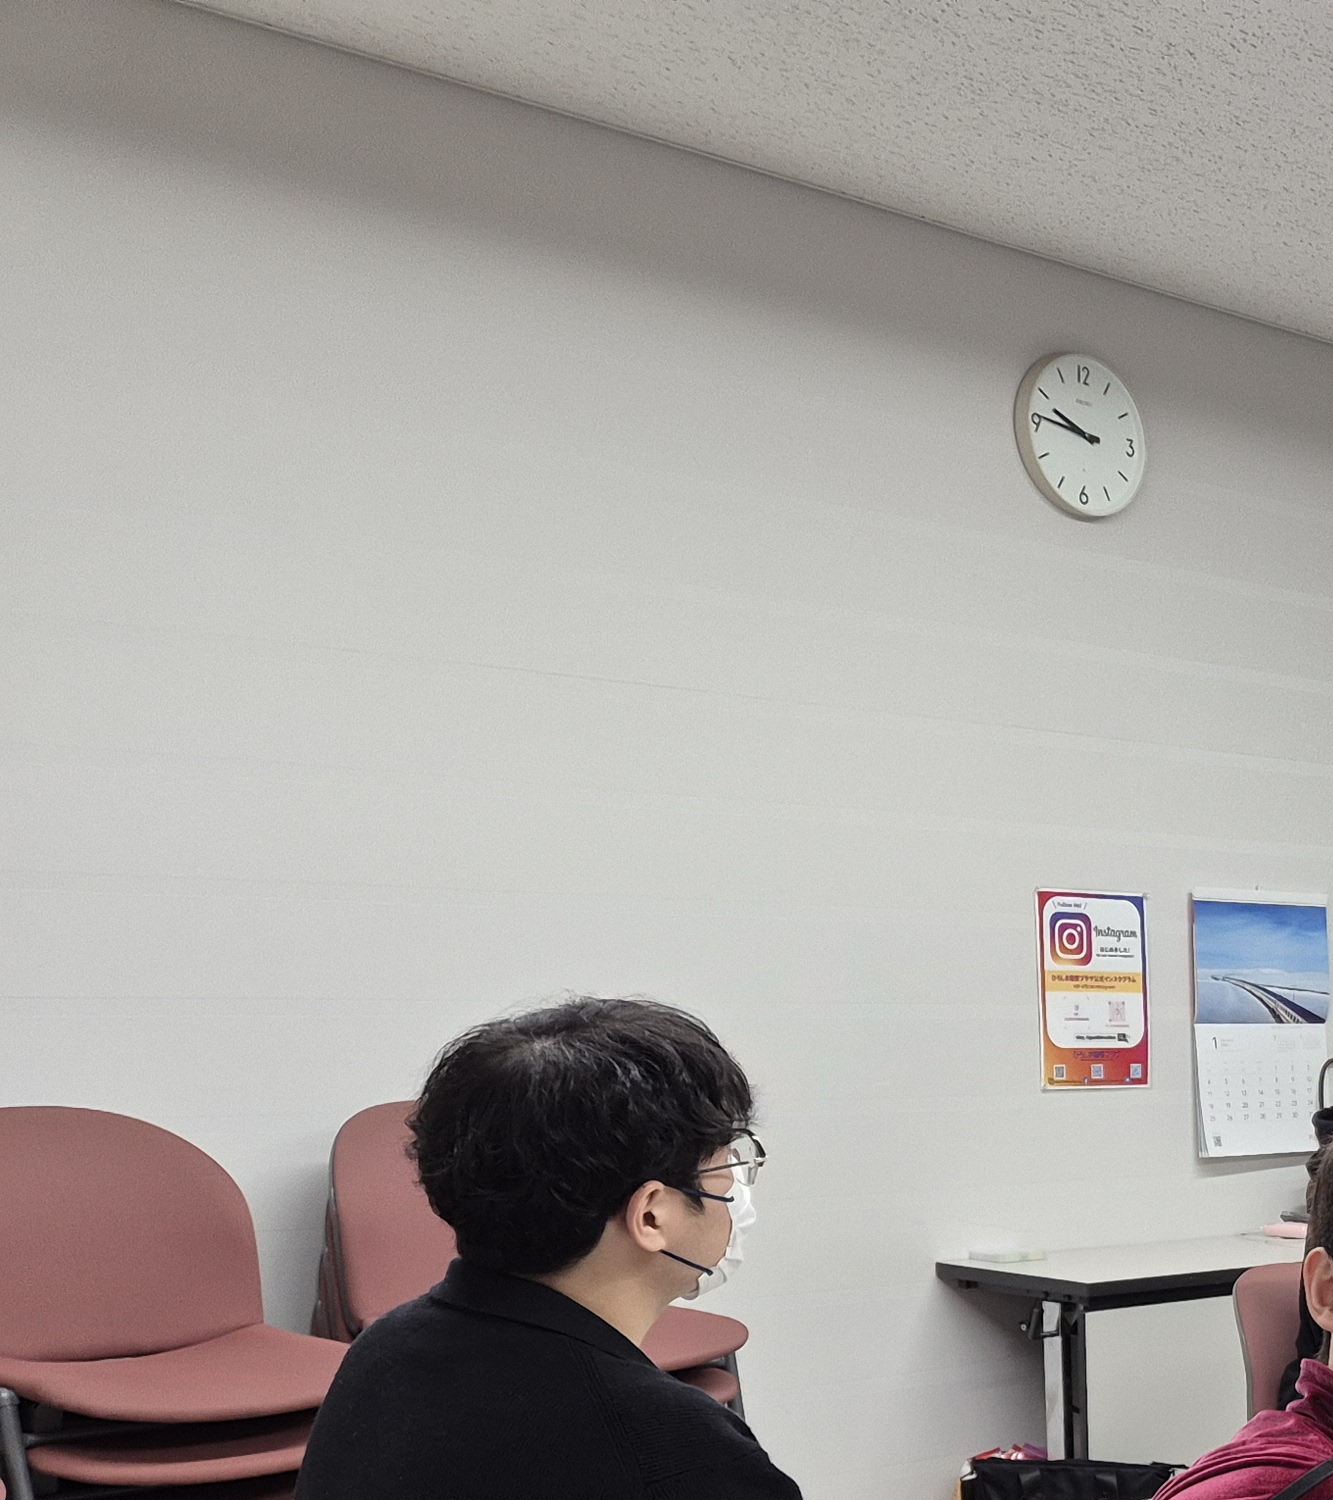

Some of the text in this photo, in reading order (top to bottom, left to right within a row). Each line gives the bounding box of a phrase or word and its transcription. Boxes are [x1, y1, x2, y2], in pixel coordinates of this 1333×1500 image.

[1077, 364, 1090, 386] 12
[1031, 412, 1042, 433] 9
[1125, 438, 1136, 458] 3
[1079, 485, 1089, 505] 6
[1093, 925, 1138, 943] Instagram
[1211, 1036, 1218, 1050] 1
